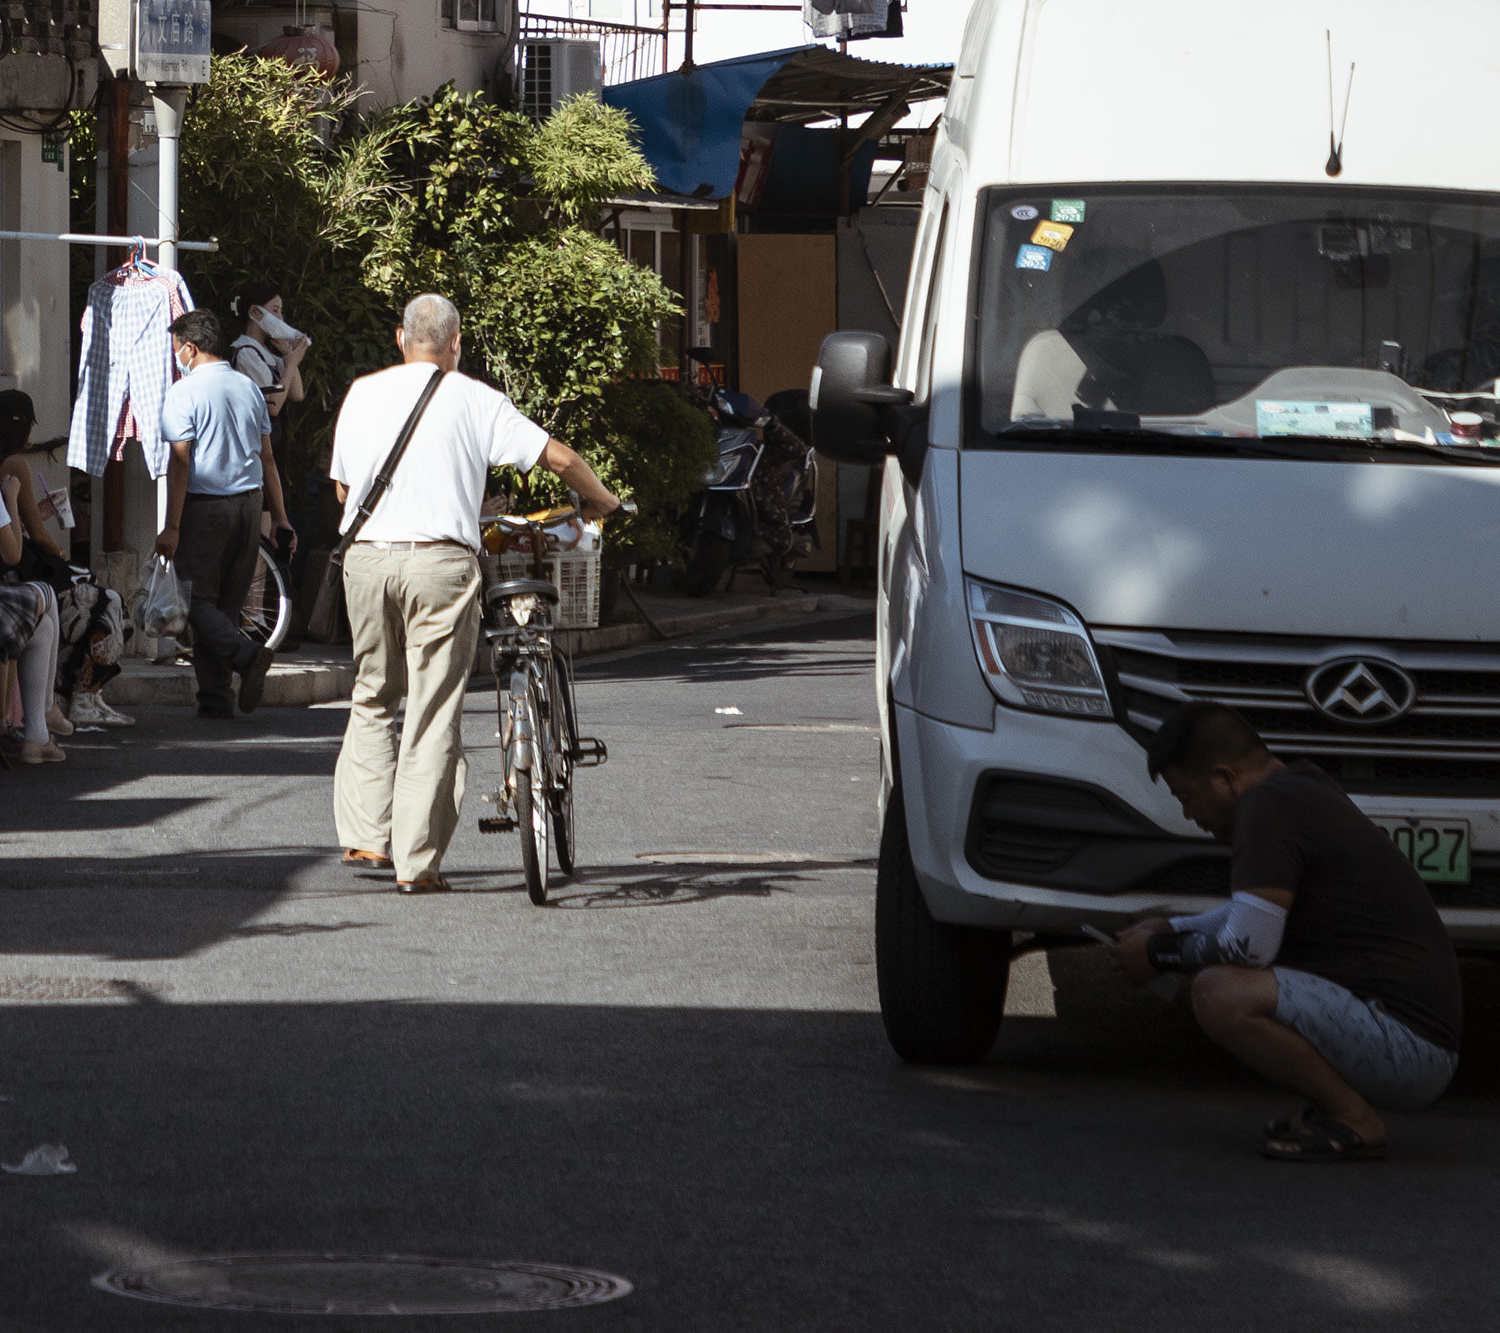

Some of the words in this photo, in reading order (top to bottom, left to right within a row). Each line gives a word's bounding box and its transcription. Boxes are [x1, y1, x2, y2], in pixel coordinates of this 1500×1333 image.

[157, 11, 194, 45] 文庙路
[1055, 212, 1081, 222] 2021
[1019, 258, 1047, 270] 2022
